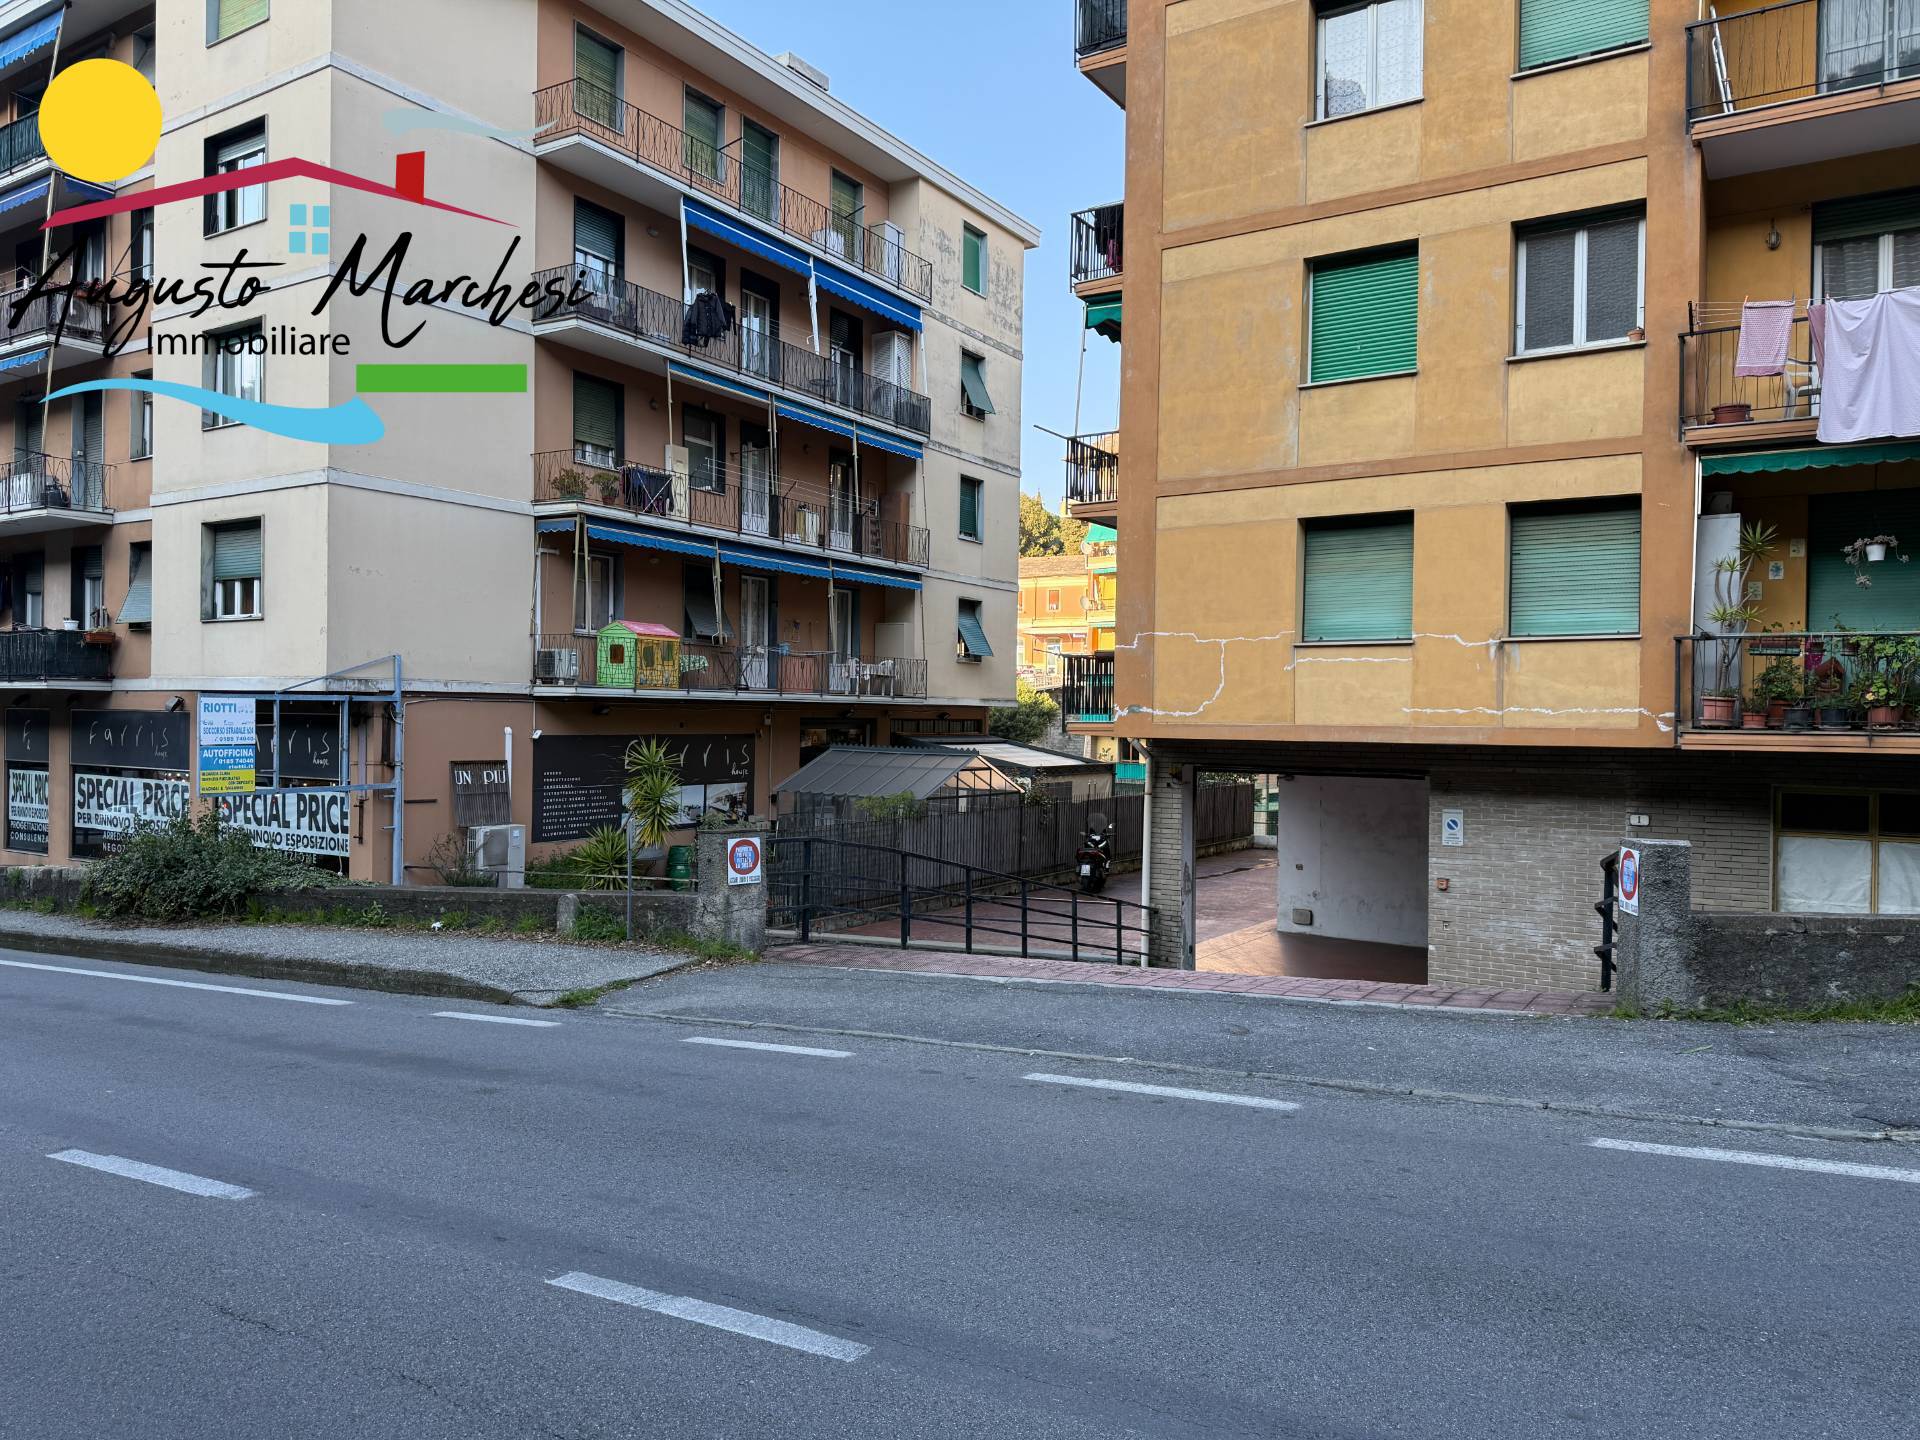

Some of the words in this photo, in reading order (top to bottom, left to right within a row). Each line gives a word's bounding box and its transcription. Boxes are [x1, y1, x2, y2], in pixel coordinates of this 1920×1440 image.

[203, 702, 237, 713] RIOTTI
[203, 749, 254, 758] AUTOFFICINA
[454, 770, 472, 785] UN
[77, 777, 137, 814] SPECIAL
[77, 812, 92, 824] PER
[94, 813, 130, 828] RINNOVO
[220, 793, 290, 828] SPECIAL
[297, 792, 348, 834] PRICE
[286, 833, 348, 852] ESPOSIZIONE
